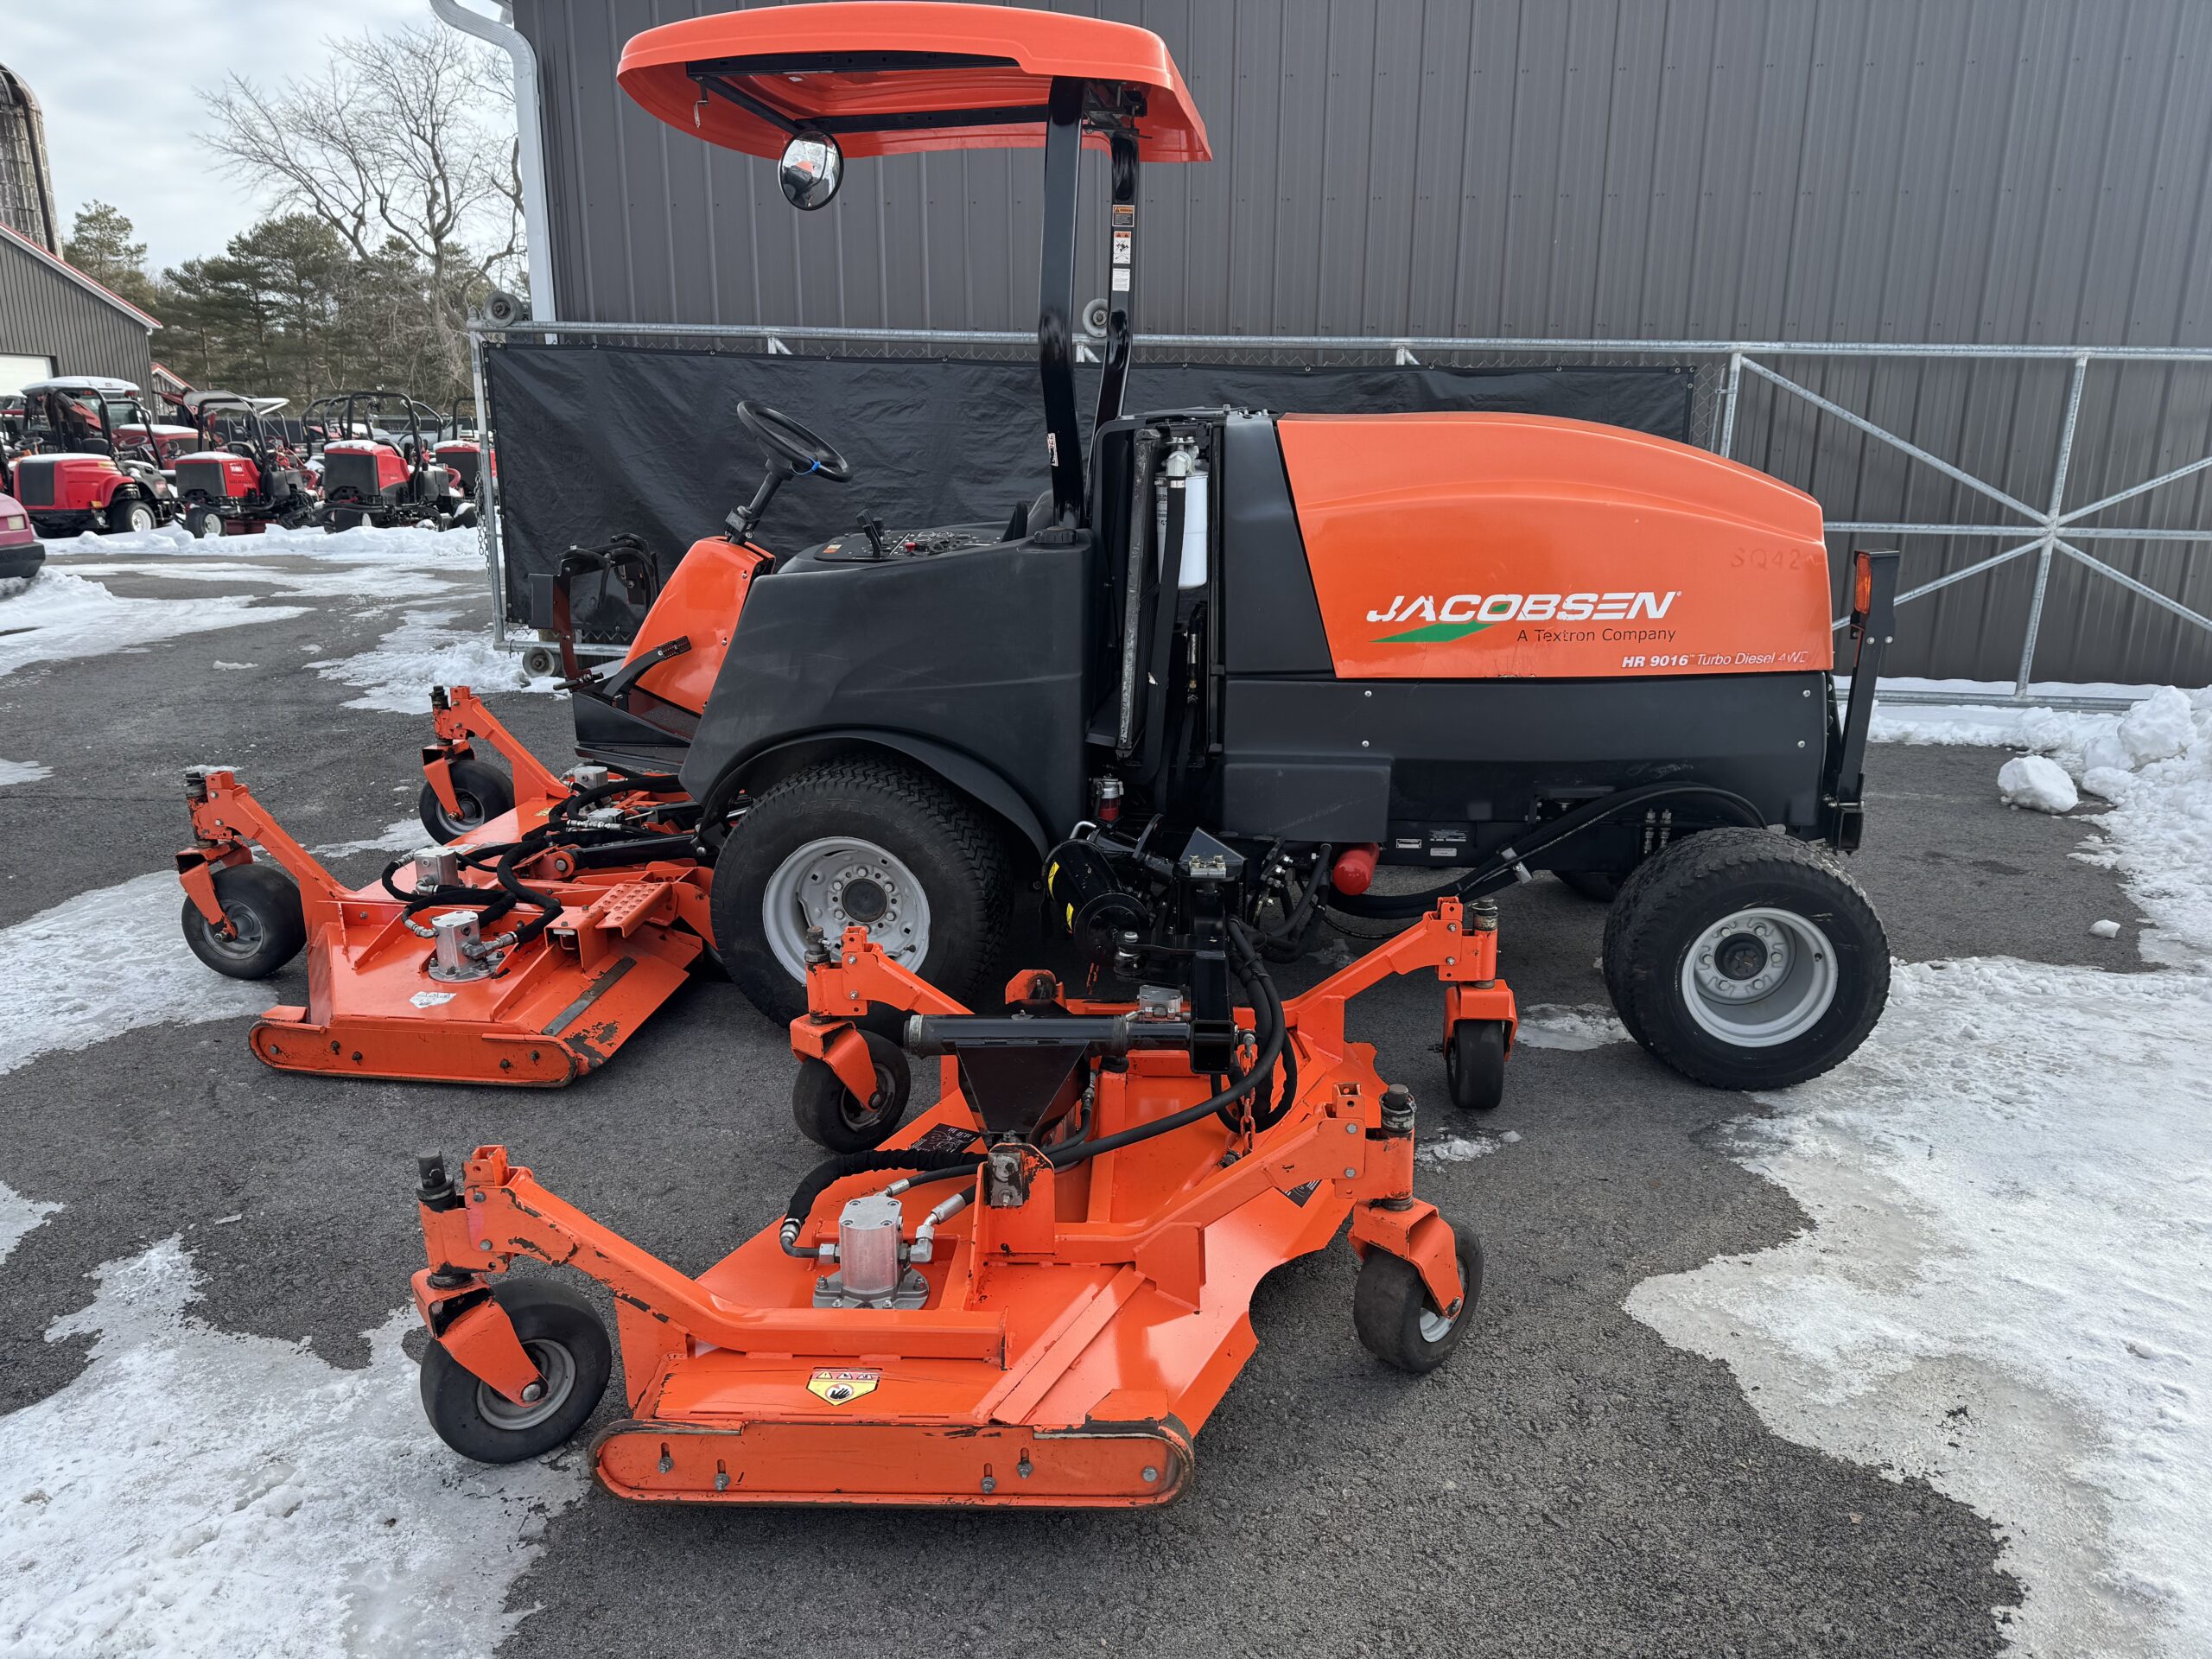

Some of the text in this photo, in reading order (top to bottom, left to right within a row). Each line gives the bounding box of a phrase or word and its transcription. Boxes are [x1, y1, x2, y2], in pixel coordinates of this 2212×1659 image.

[1366, 591, 1676, 622] JACOBSEN
[1516, 628, 1676, 644] A Textron Company
[1622, 656, 1646, 668] HR
[1697, 653, 1732, 665] Turbo
[1735, 652, 1776, 664] Diesel
